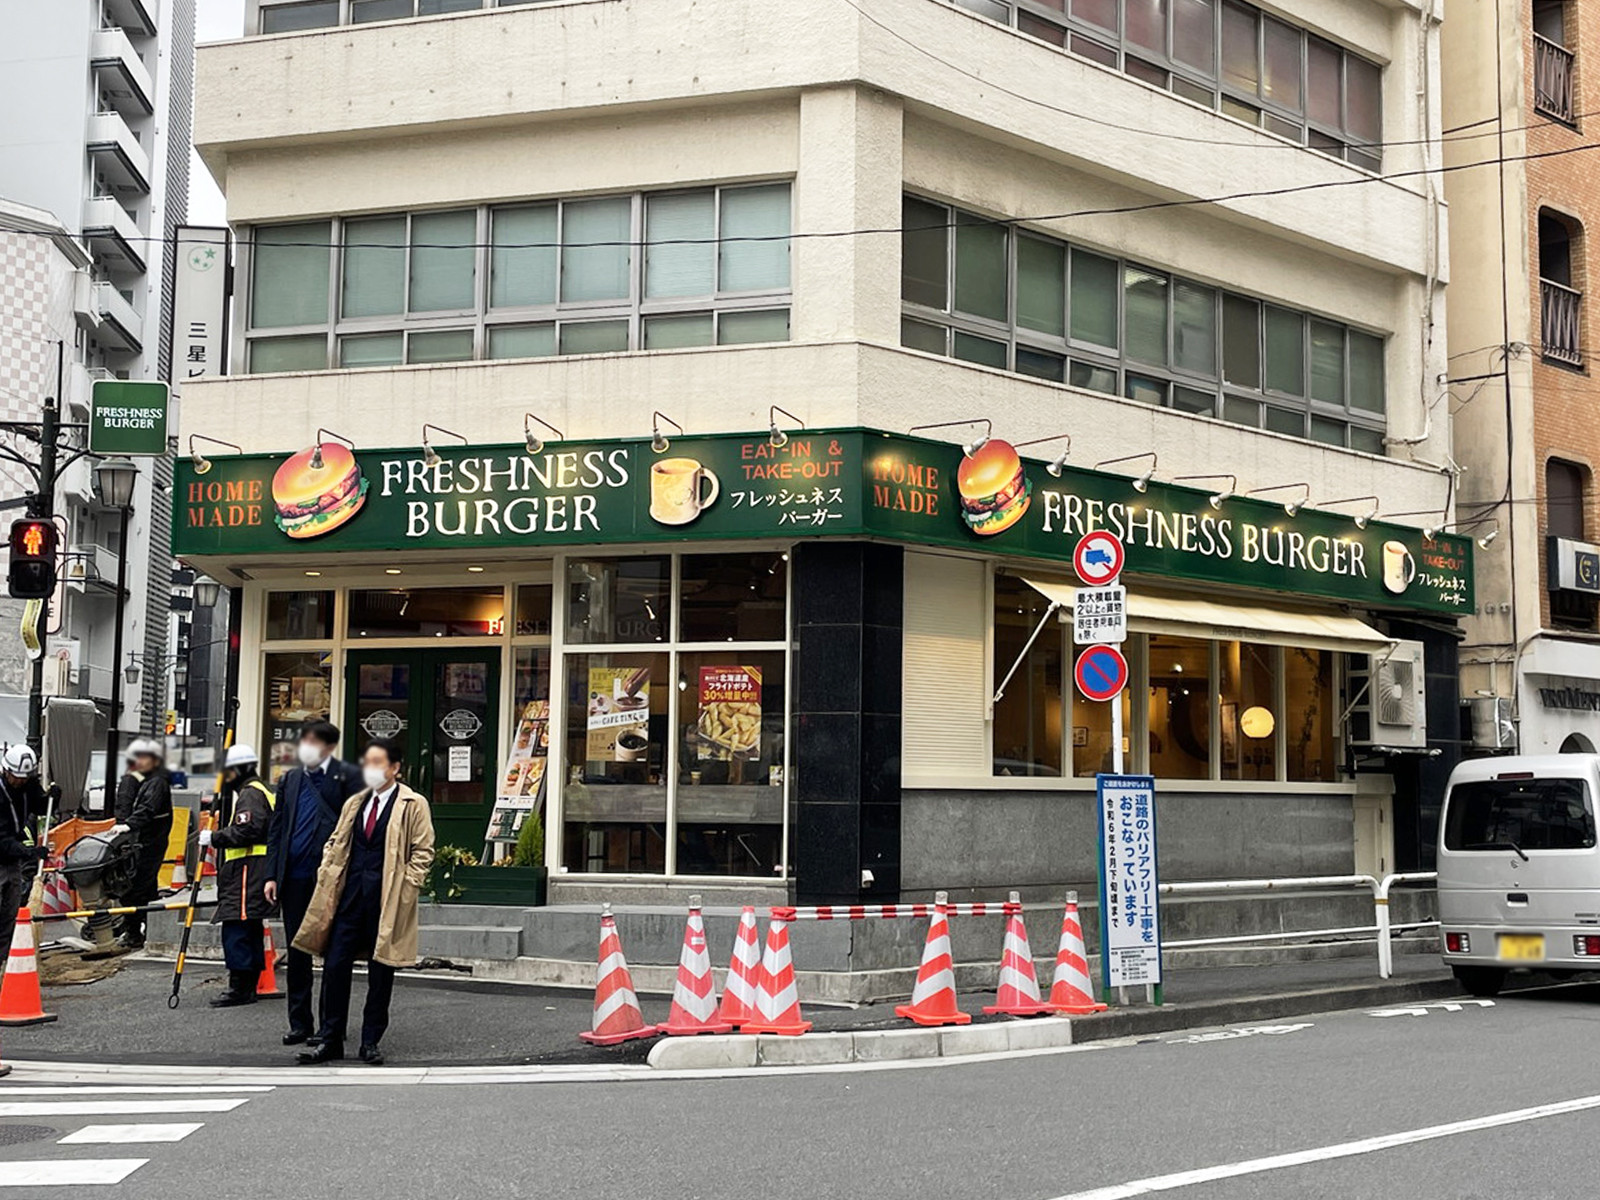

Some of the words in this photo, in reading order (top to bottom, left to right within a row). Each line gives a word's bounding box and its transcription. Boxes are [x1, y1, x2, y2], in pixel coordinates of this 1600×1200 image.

[96, 407, 163, 420] FRESHNESS
[104, 418, 155, 430] BURGER
[741, 441, 811, 460] EAT-IN
[828, 440, 843, 457] &
[380, 449, 629, 497] FRESHNESS
[741, 460, 844, 480] TAKE-OUT
[873, 459, 939, 490] HOME
[187, 480, 263, 504] HOME
[730, 486, 843, 508] フレッシュネス
[873, 484, 939, 516] MADE
[187, 504, 262, 528] MADE
[405, 494, 601, 537] BURGER
[778, 508, 843, 526] バーガー
[1041, 490, 1232, 559] FRESHNESS
[1242, 523, 1368, 578] BURGER
[1421, 554, 1465, 571] TAKE-OUT
[1418, 573, 1467, 592] フレッシュネス
[1439, 592, 1468, 606] バーガー
[1120, 796, 1138, 928] おこなっています
[1135, 794, 1153, 943] 道路のバリアフリー工事を
